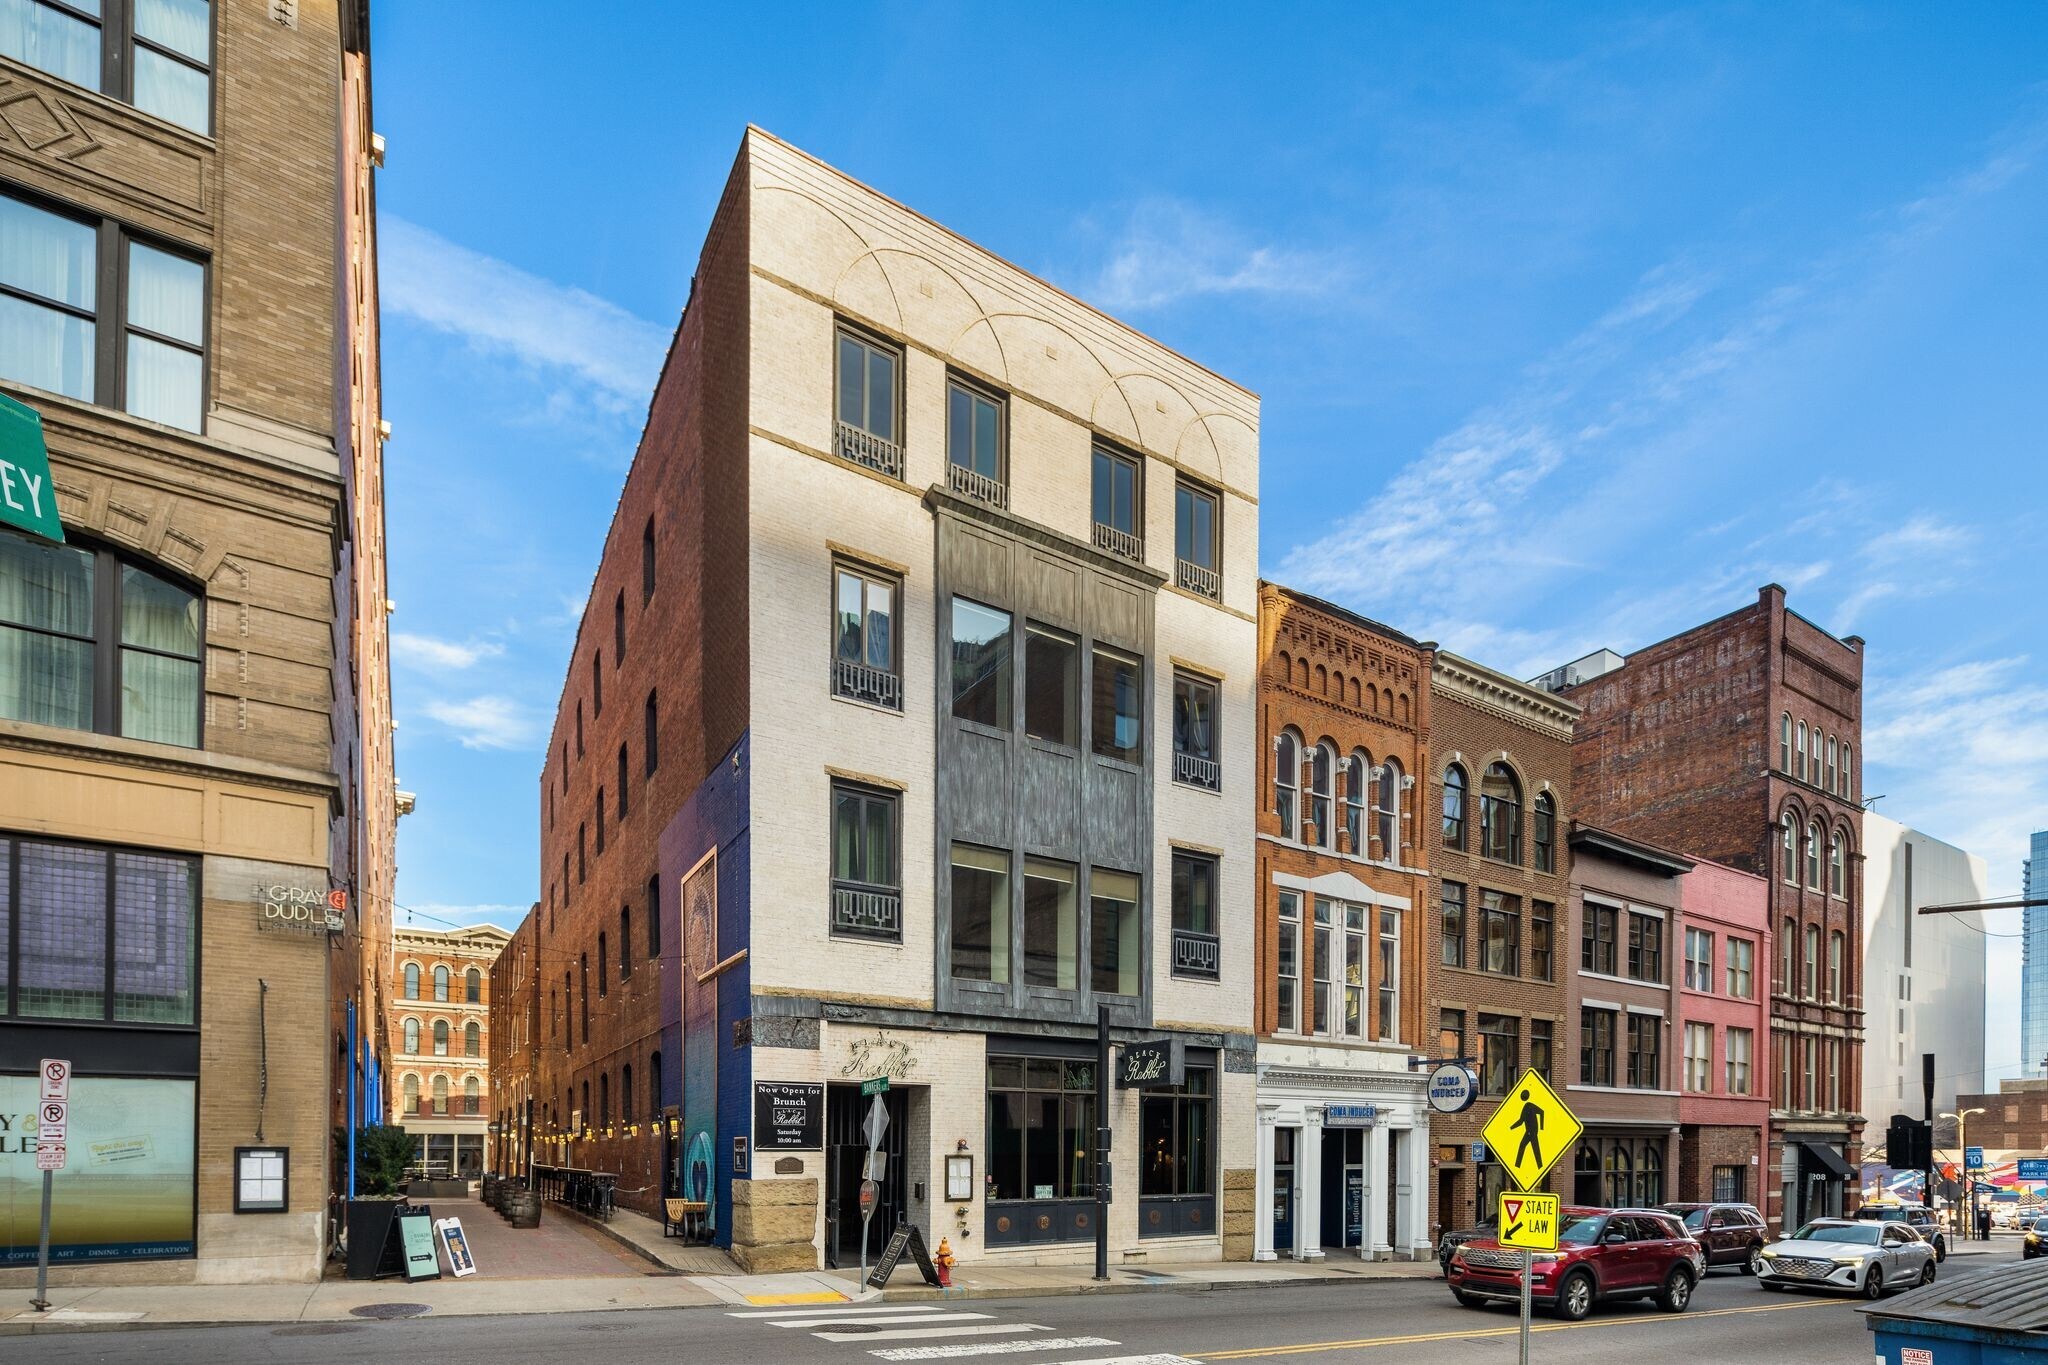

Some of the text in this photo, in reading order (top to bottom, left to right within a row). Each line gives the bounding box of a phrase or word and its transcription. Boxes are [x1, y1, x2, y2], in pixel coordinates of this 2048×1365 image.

[269, 886, 327, 905] GRAY
[1129, 1049, 1161, 1062] BLACK
[1125, 1058, 1166, 1081] Rabbit
[1437, 1076, 1460, 1086] COMA
[782, 1087, 805, 1095] Open
[807, 1086, 820, 1094] for
[1431, 1087, 1466, 1098] INDUCER
[773, 1097, 807, 1106] Brunch
[1329, 1105, 1374, 1117] COMA INDUCER
[777, 1129, 802, 1137] Saturday
[1525, 1200, 1553, 1215] STATE
[1528, 1219, 1549, 1234] LAW
[132, 1246, 190, 1254] CELEBRATION
[1903, 1349, 1930, 1359] NOTICE
